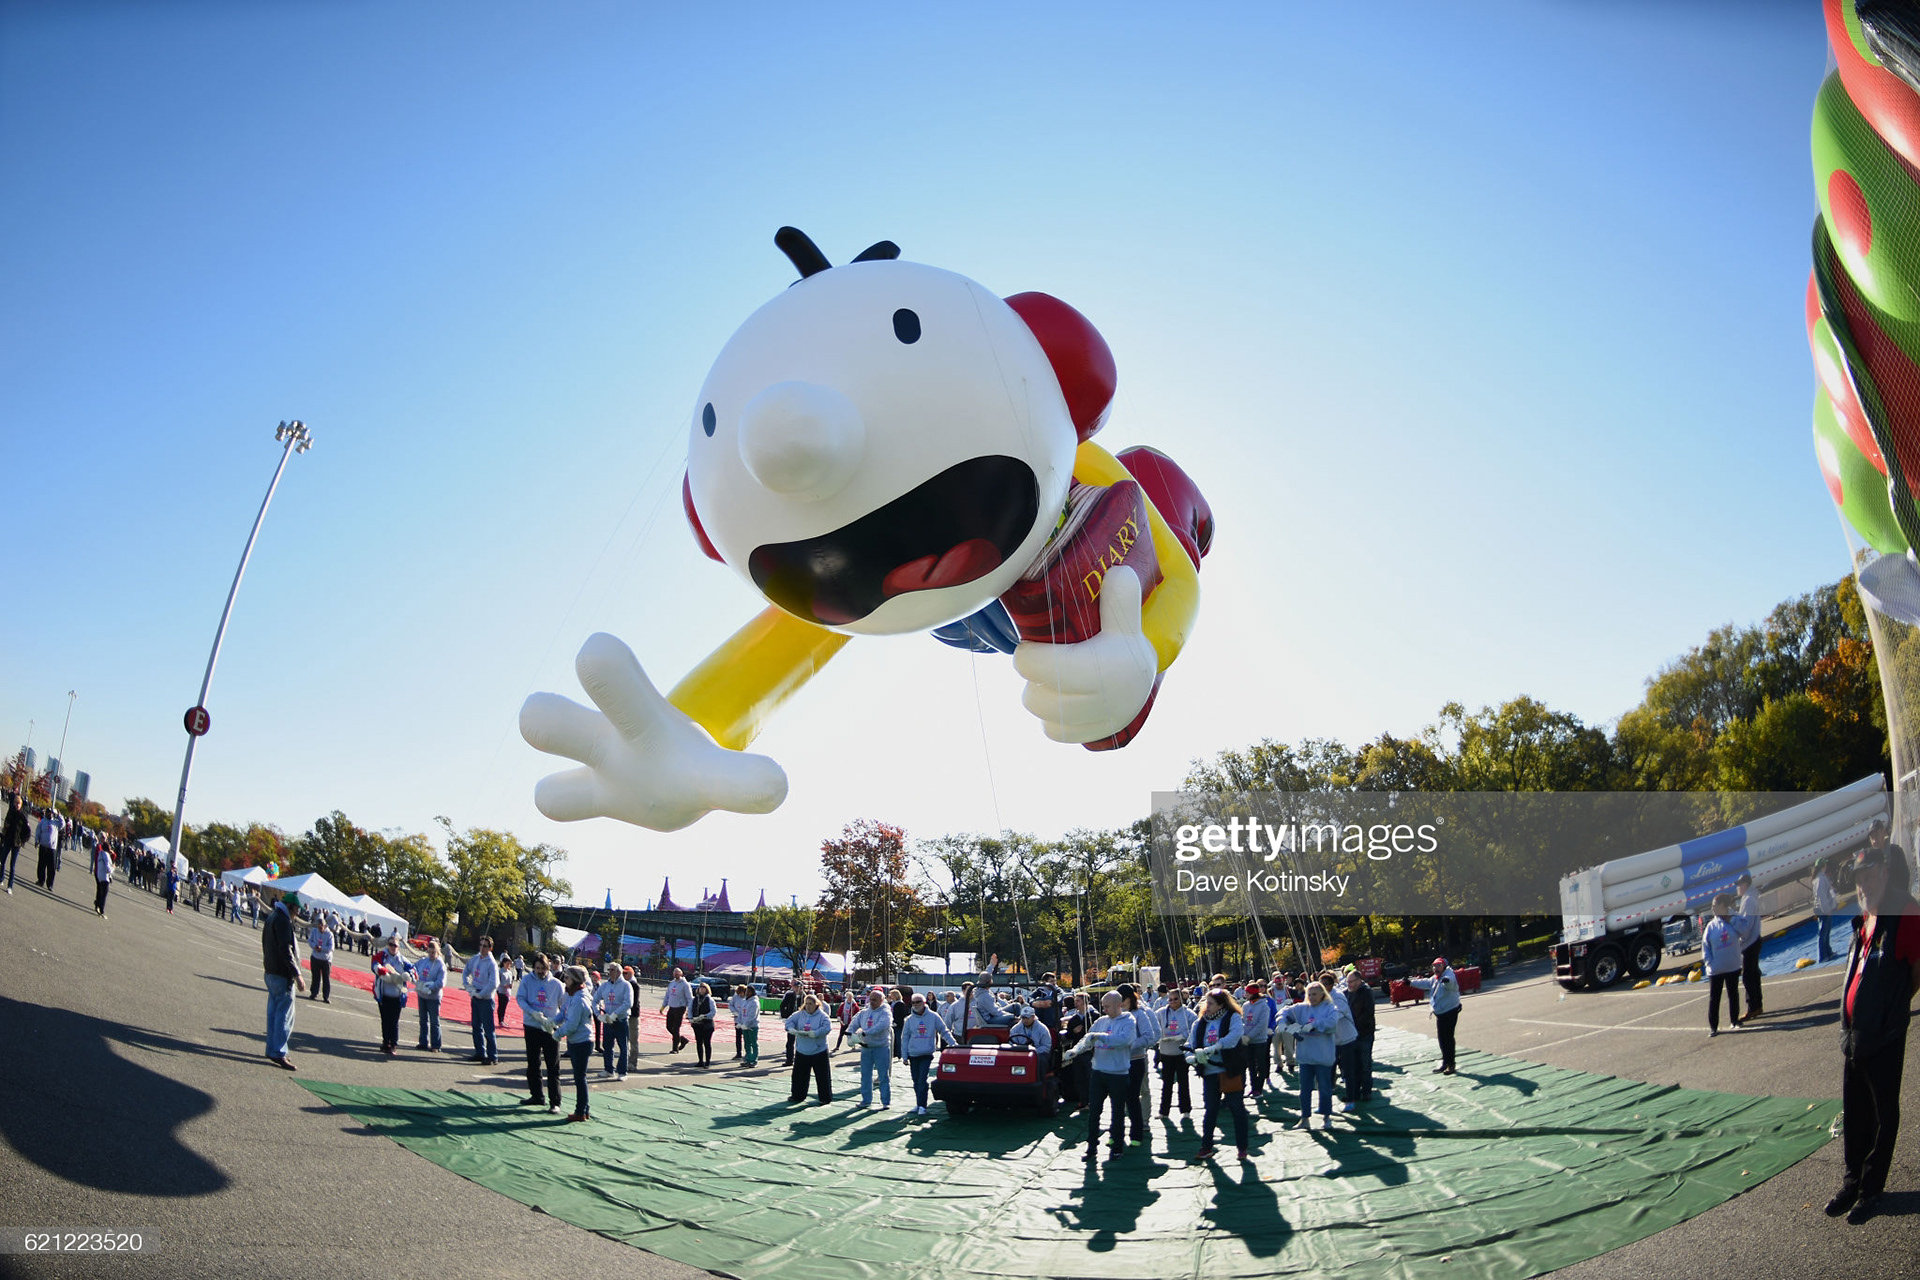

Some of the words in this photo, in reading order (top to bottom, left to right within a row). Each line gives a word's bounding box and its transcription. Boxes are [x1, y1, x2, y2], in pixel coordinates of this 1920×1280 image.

[1082, 506, 1140, 603] DIARY
[193, 709, 206, 732] E
[1690, 861, 1723, 880] Linde
